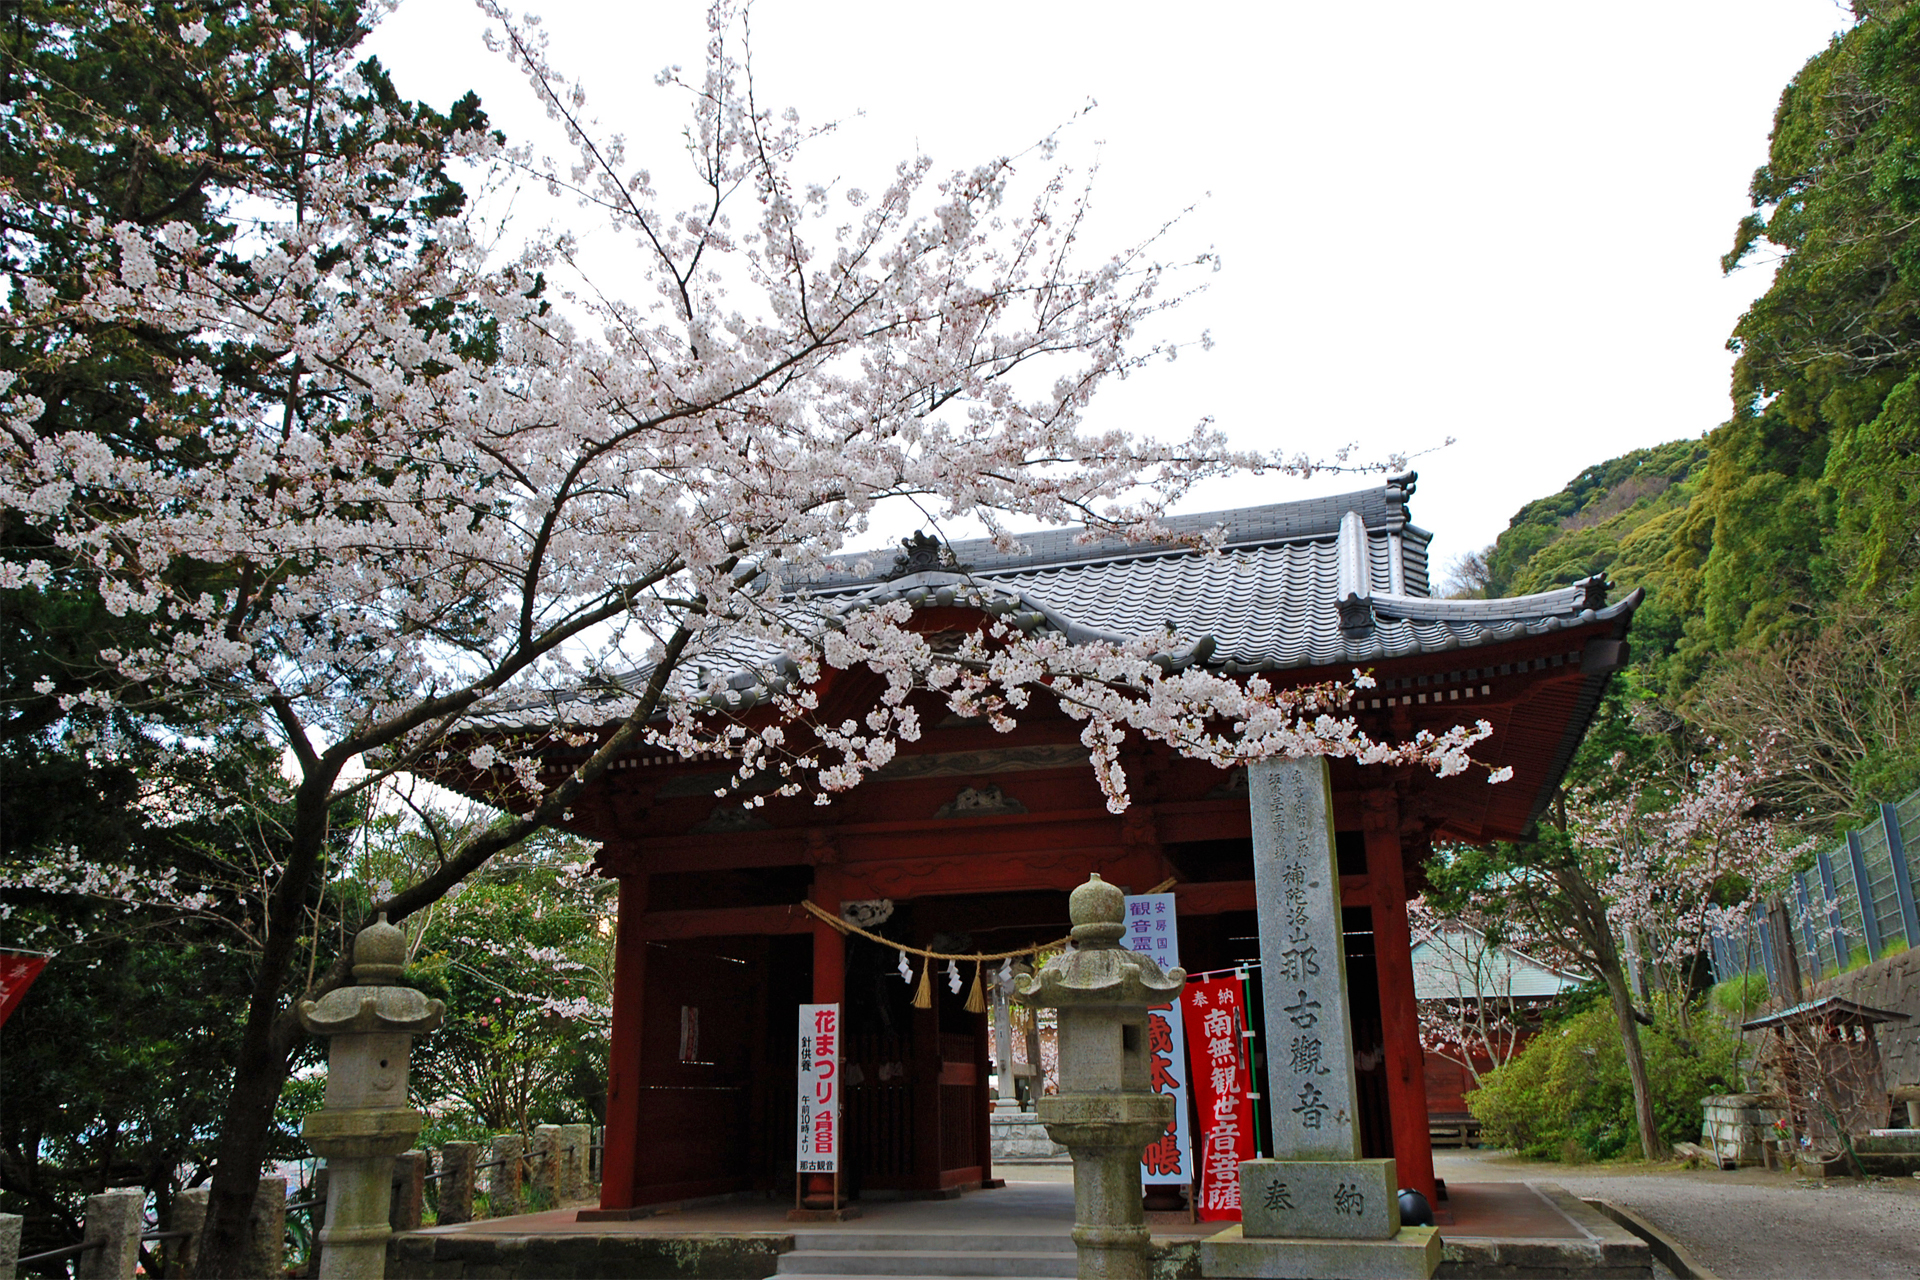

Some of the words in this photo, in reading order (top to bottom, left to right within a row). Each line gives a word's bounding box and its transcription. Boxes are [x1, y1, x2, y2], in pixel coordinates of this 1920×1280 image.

[1130, 901, 1152, 957] 観音霊
[801, 1036, 811, 1072] 針供養
[814, 1010, 836, 1105] 花まつり
[814, 1110, 833, 1153] 4月8日
[1203, 1007, 1242, 1211] 南無観世音菩薩
[800, 1160, 834, 1171] 那古観音
